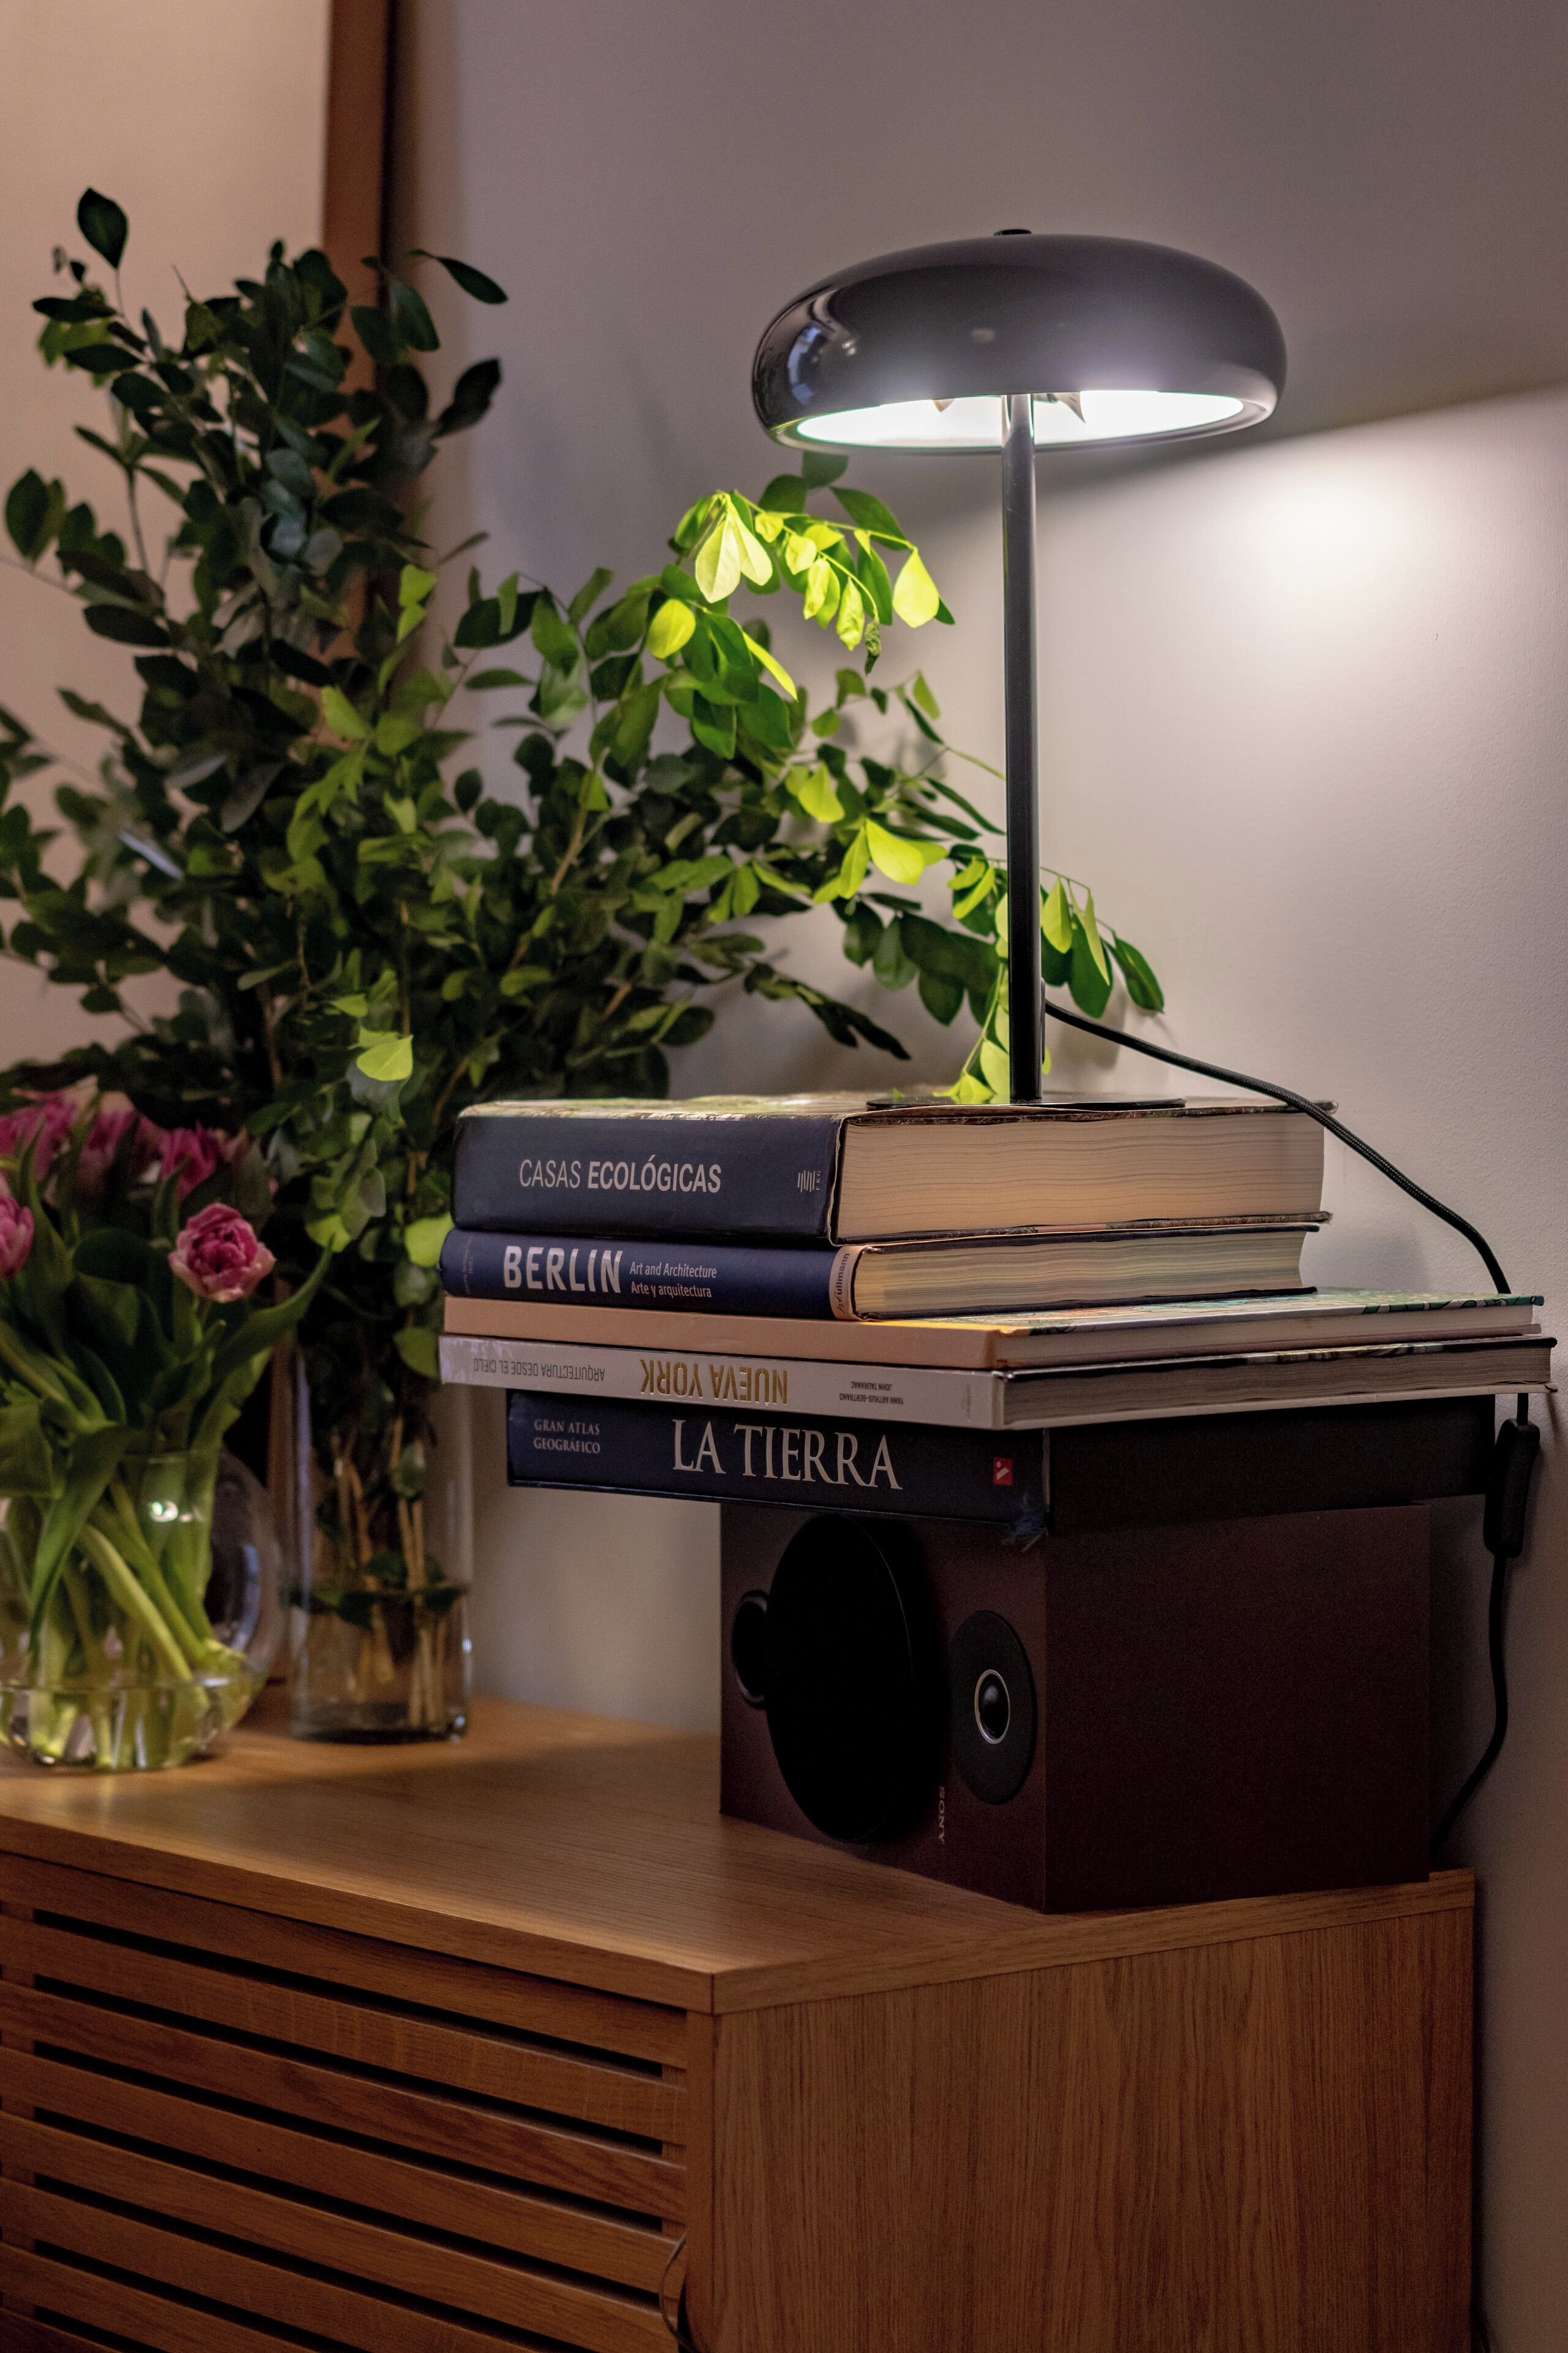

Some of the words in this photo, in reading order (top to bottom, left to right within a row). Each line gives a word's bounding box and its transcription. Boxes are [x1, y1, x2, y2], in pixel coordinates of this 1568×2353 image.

[520, 1159, 581, 1189] CASAS
[587, 1154, 722, 1194] ECOLÓGICAS
[503, 1245, 623, 1294] BERLIN
[629, 1261, 643, 1275] Art
[645, 1262, 662, 1276] and
[663, 1262, 717, 1278] Architecture
[631, 1281, 649, 1295] Arte
[650, 1286, 657, 1298] y
[658, 1283, 713, 1299] arquitectura
[473, 1358, 497, 1373] CIELO
[498, 1360, 509, 1374] EL
[511, 1361, 539, 1376] DESDE
[541, 1364, 605, 1382] ARQUITECTURA
[640, 1359, 703, 1399] YORK
[709, 1363, 788, 1405] NUEVA
[850, 1381, 877, 1391] TAURANAC
[878, 1383, 893, 1392] JOHN
[839, 1393, 889, 1404] ARTHUS-BERTRAND
[534, 1419, 565, 1433] GRAN
[568, 1421, 600, 1436] ATLAS
[533, 1437, 600, 1454] GEOGRÁFICO
[672, 1419, 727, 1474] LA
[733, 1423, 903, 1490] TIERRA
